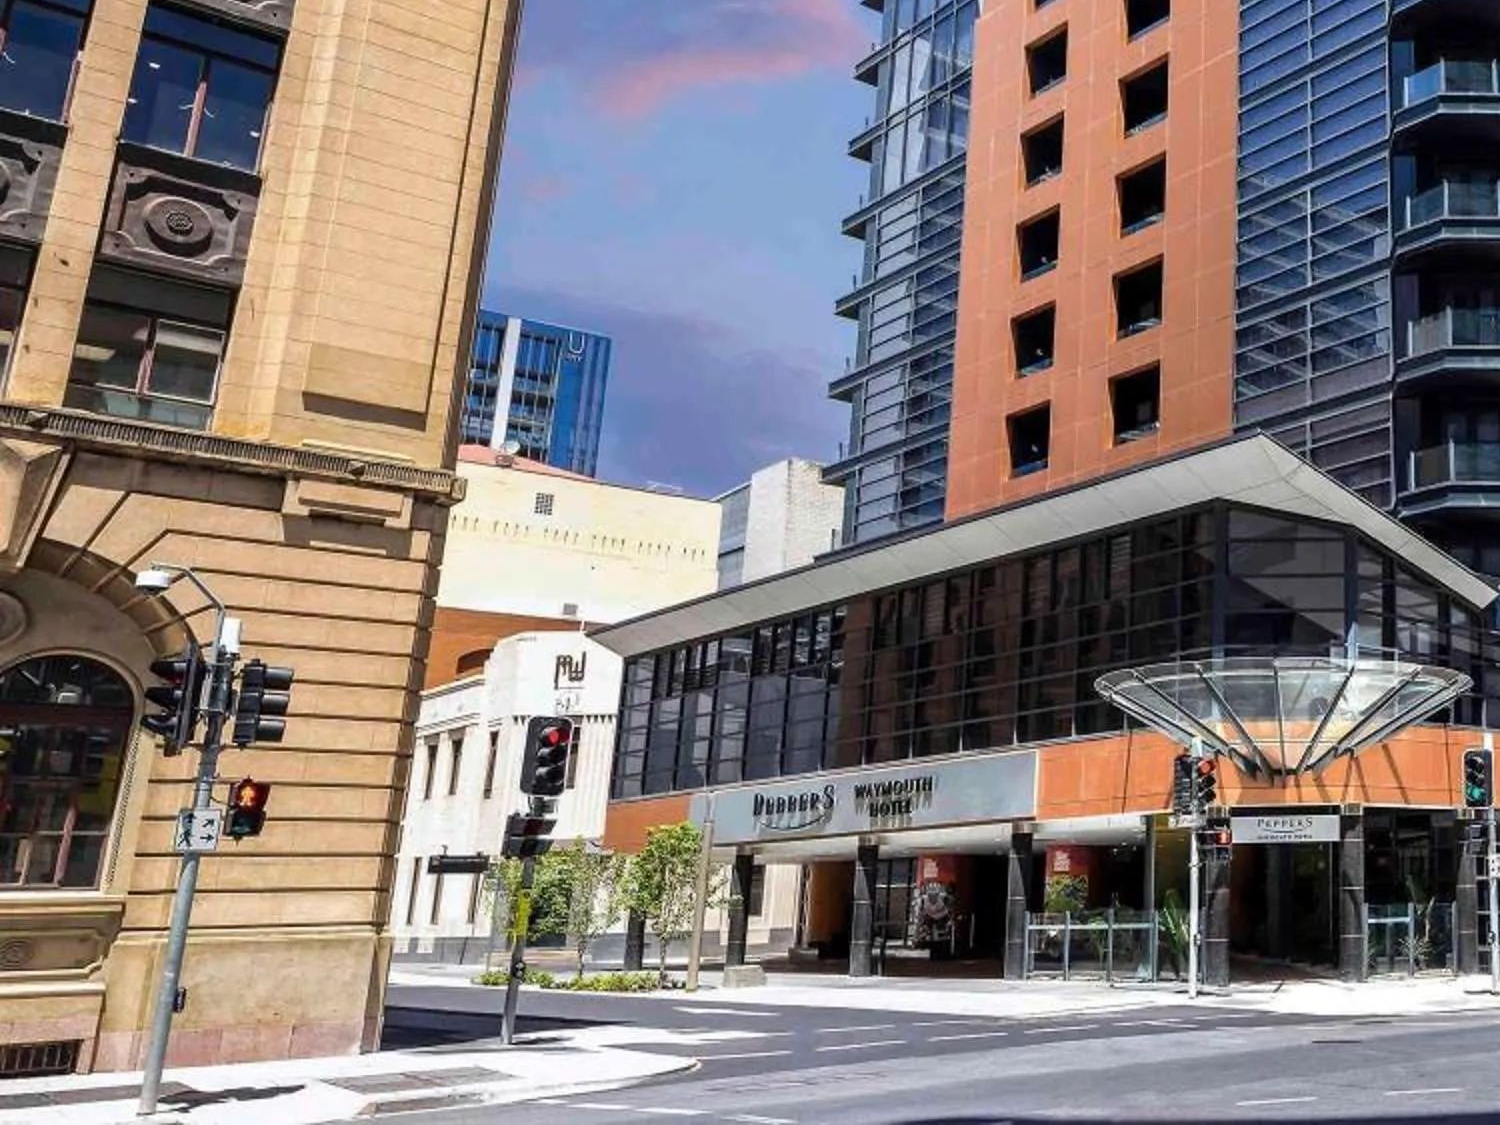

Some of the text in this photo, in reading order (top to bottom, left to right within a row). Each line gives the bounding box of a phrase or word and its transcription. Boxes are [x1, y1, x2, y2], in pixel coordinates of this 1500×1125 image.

[853, 776, 934, 800] WAYMOUTH
[753, 784, 836, 816] PEPPERS
[869, 798, 914, 818] HOTEL
[1257, 817, 1314, 829] PEPPERS
